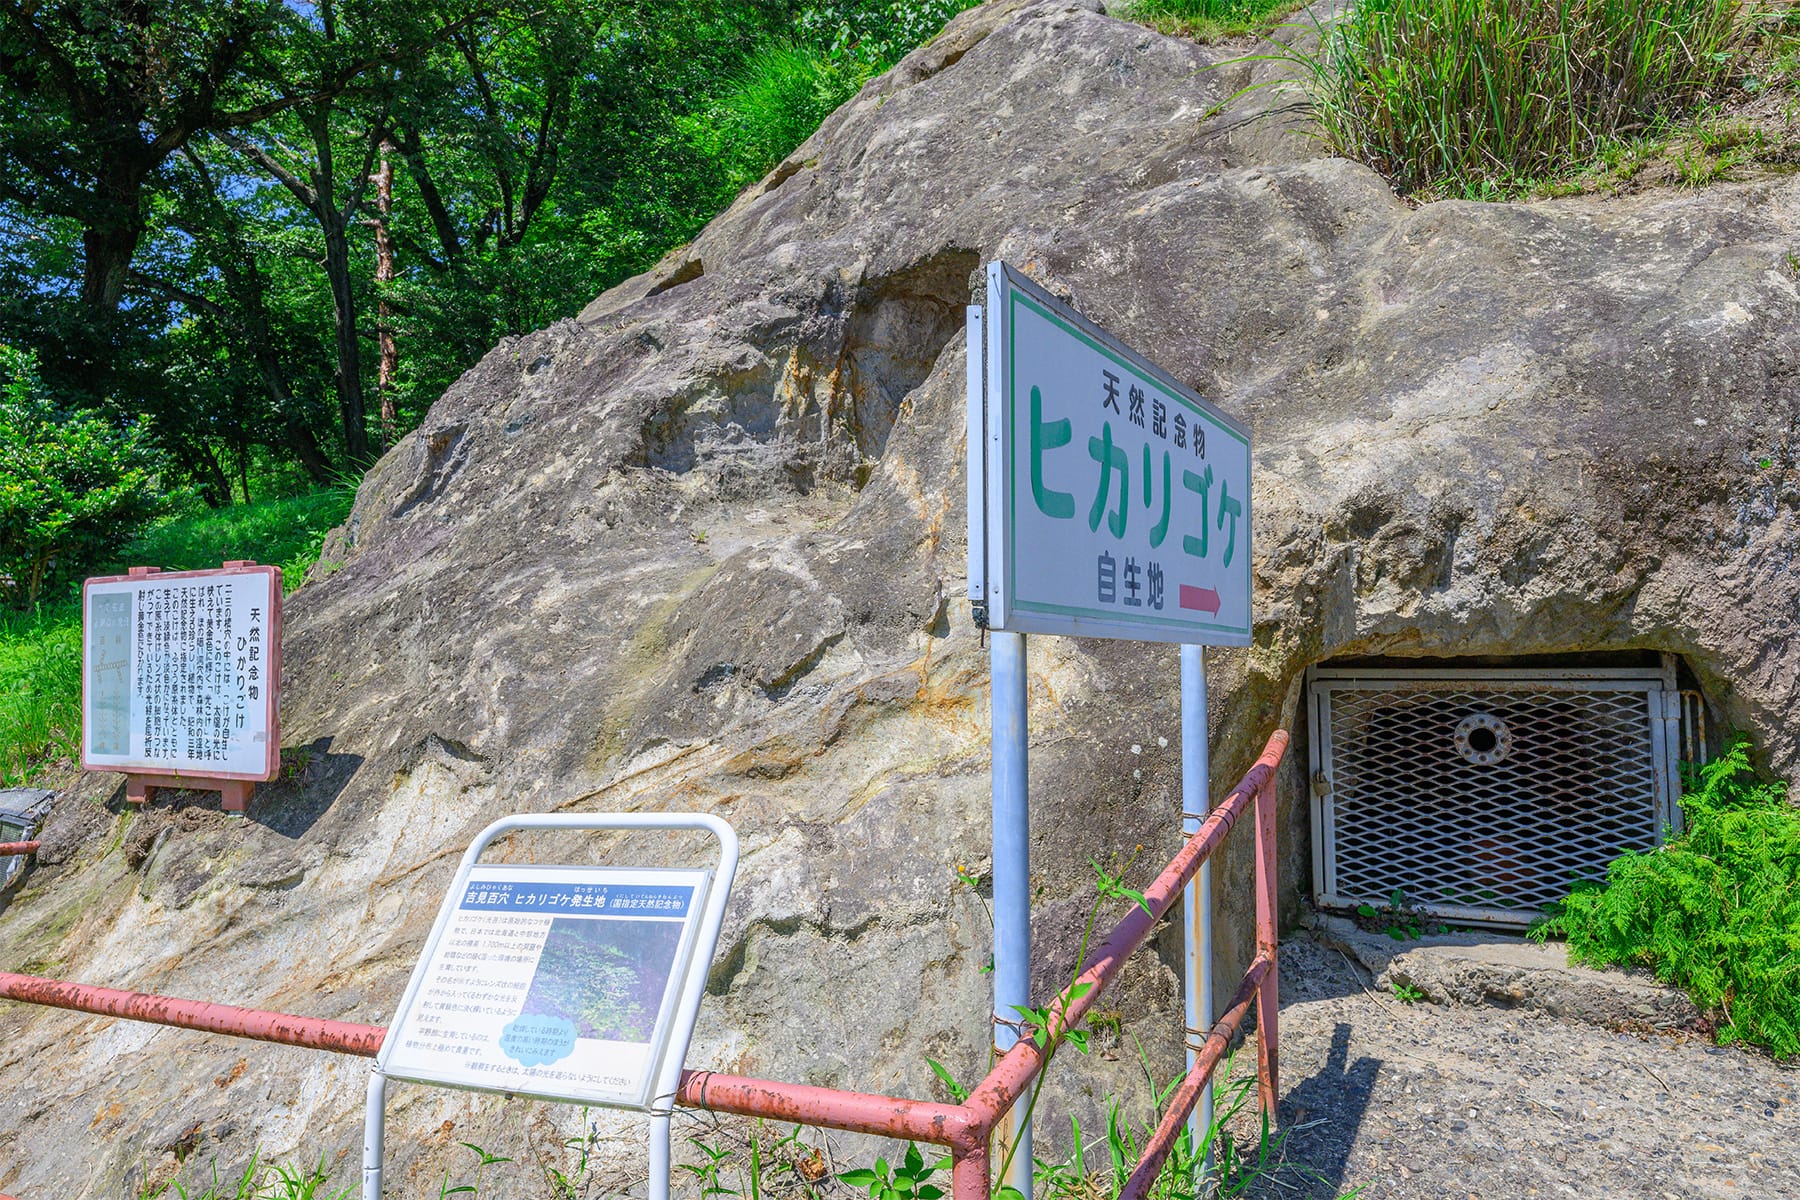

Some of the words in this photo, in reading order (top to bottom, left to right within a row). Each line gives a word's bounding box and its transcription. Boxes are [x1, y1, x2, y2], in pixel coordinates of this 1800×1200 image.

[1103, 369, 1205, 460] 天然記念物
[1030, 385, 1242, 568] ヒカリゴケ
[1098, 550, 1164, 610] 自生地
[236, 636, 247, 729] ひかりごけ
[248, 607, 261, 701] 天然記念物
[465, 891, 510, 905] 吉見百穴
[514, 893, 607, 909] ヒカリゴケ発生地
